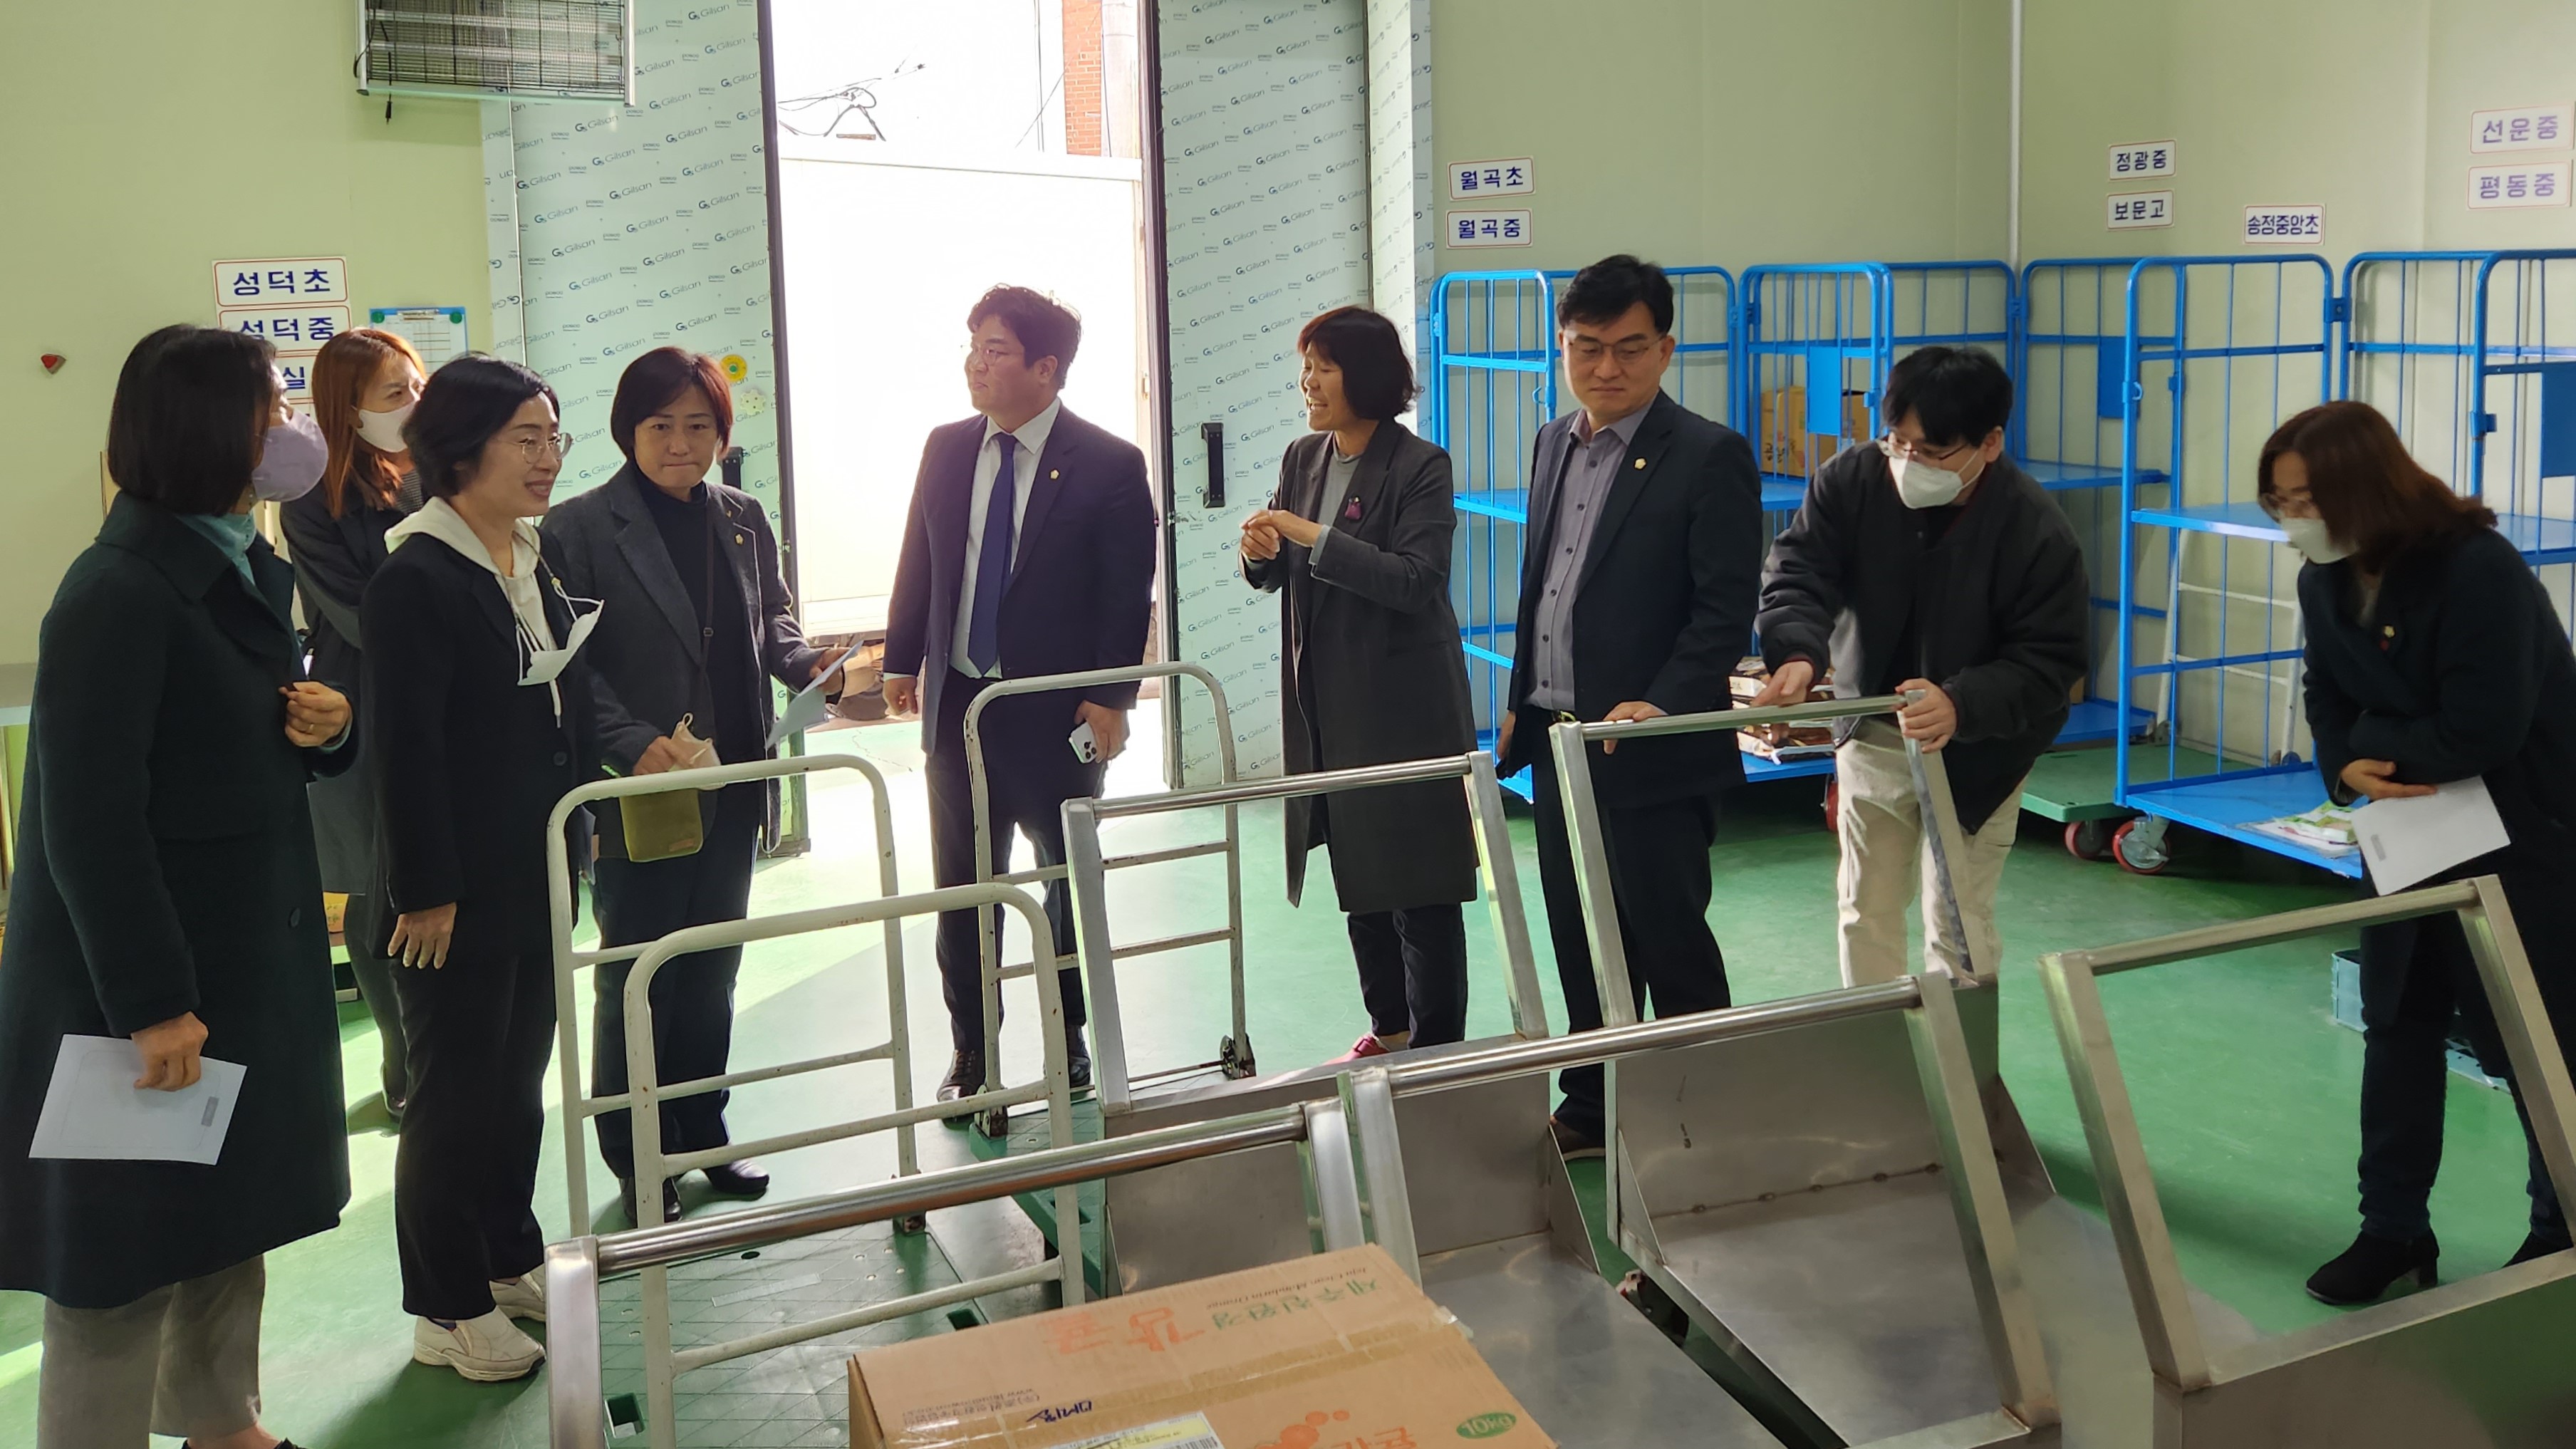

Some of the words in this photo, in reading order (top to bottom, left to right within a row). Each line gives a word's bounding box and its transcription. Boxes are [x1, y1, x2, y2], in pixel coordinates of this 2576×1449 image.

[2483, 115, 2558, 144] 선운중
[2117, 150, 2166, 172] 정광중
[1460, 167, 1524, 190] 월곡초
[2480, 173, 2555, 199] 평동중
[2114, 199, 2164, 220] 보문고
[1458, 219, 1520, 239] 월곡중
[2248, 214, 2319, 235] 송정중앙초
[233, 268, 331, 296] 성덕초
[241, 317, 334, 341] 성덕중
